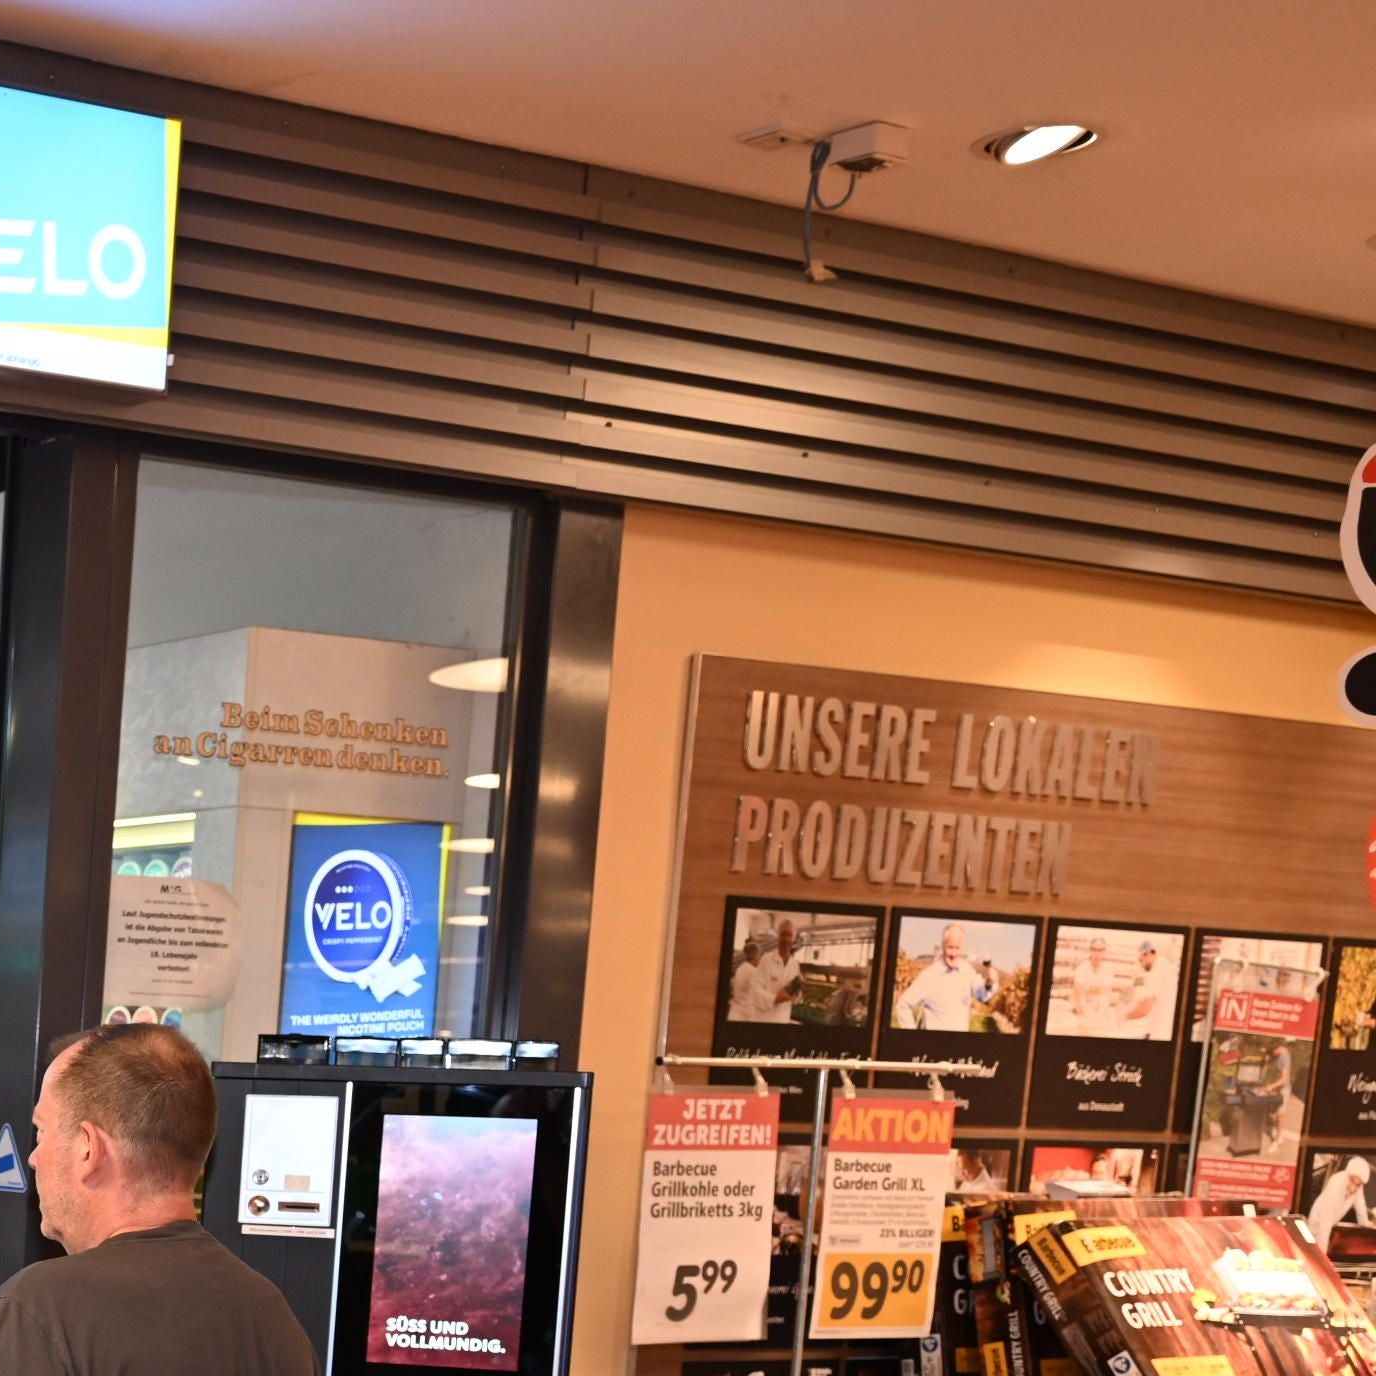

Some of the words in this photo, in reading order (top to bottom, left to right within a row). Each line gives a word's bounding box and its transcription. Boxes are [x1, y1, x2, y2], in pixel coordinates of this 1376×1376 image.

[219, 700, 301, 736] Beim
[303, 708, 449, 748] Schenken
[152, 731, 193, 757] an
[196, 731, 333, 767] Cigarren
[336, 742, 451, 778] denken.
[746, 690, 938, 784] UNSERE
[951, 712, 1161, 807] LOKALEN
[730, 795, 1073, 896] PRODUZENTEN
[314, 900, 393, 931] VELO
[290, 1014, 312, 1027] THE
[313, 1012, 359, 1026] WEIRDLY
[359, 1008, 424, 1023] WONDERFUL
[1219, 997, 1248, 1022] IN
[337, 1022, 386, 1036] NICOTINE
[387, 1020, 425, 1033] POUCH
[682, 1099, 746, 1121] JETZT
[653, 1124, 772, 1146] ZUGREIFEN!
[831, 1108, 950, 1144] AKTION
[652, 1160, 718, 1177] Barbecue
[834, 1158, 892, 1173] Barbecue
[650, 1181, 719, 1198] Grillkohle
[723, 1182, 756, 1197] oder
[832, 1176, 878, 1191] Garden
[881, 1177, 908, 1191] Grill
[911, 1178, 926, 1191] XL
[650, 1201, 734, 1219] Grillbriketts
[737, 1202, 764, 1222] 3kg
[1017, 1248, 1052, 1298] COUNTRY
[1042, 1287, 1067, 1322] GRILL
[1103, 1267, 1195, 1298] COUNTRY
[385, 1314, 428, 1335] SÜSS
[429, 1319, 469, 1336] UND
[1008, 1309, 1022, 1340] GRILL
[1121, 1302, 1184, 1330] GRILL
[385, 1331, 506, 1355] VOLLMUNDIG.
